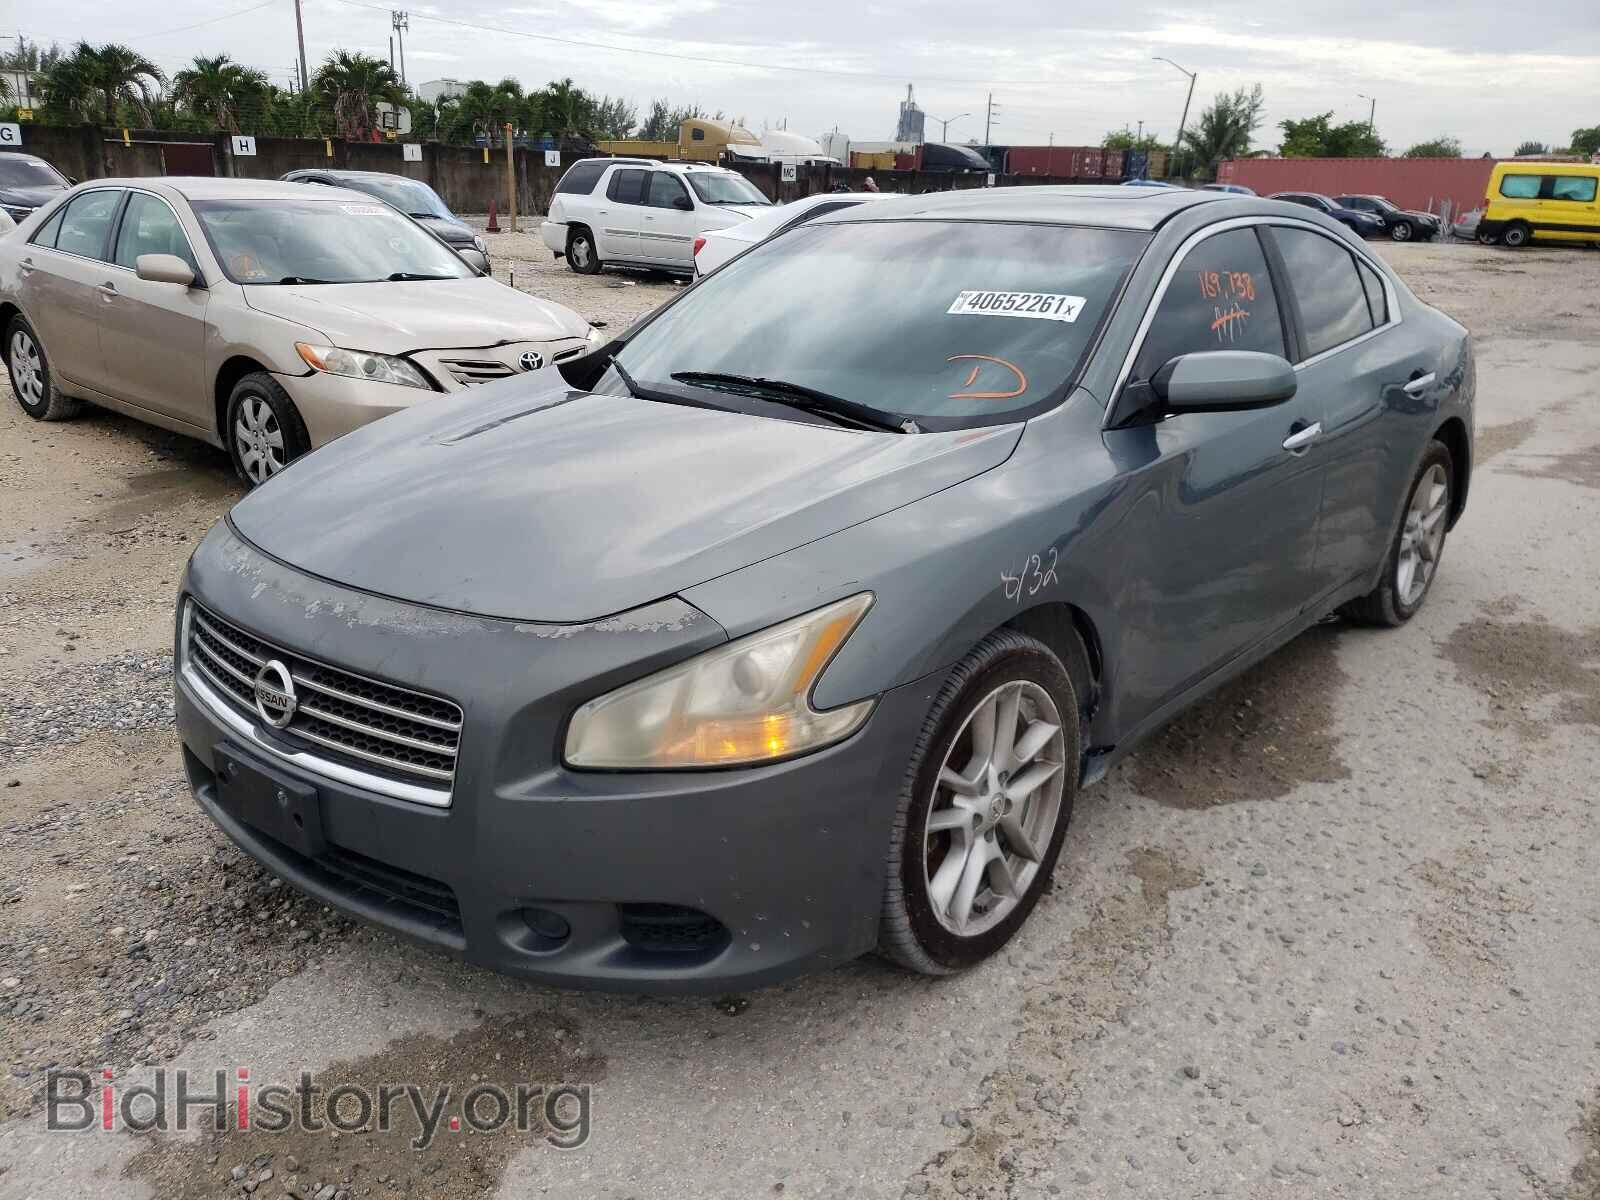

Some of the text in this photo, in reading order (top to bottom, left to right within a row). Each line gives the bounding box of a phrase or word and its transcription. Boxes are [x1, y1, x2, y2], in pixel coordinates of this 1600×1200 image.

[0, 127, 12, 141] G
[239, 139, 250, 152] H
[783, 167, 794, 178] MC
[968, 292, 1066, 315] 40652261
[256, 686, 287, 707] NISSAN
